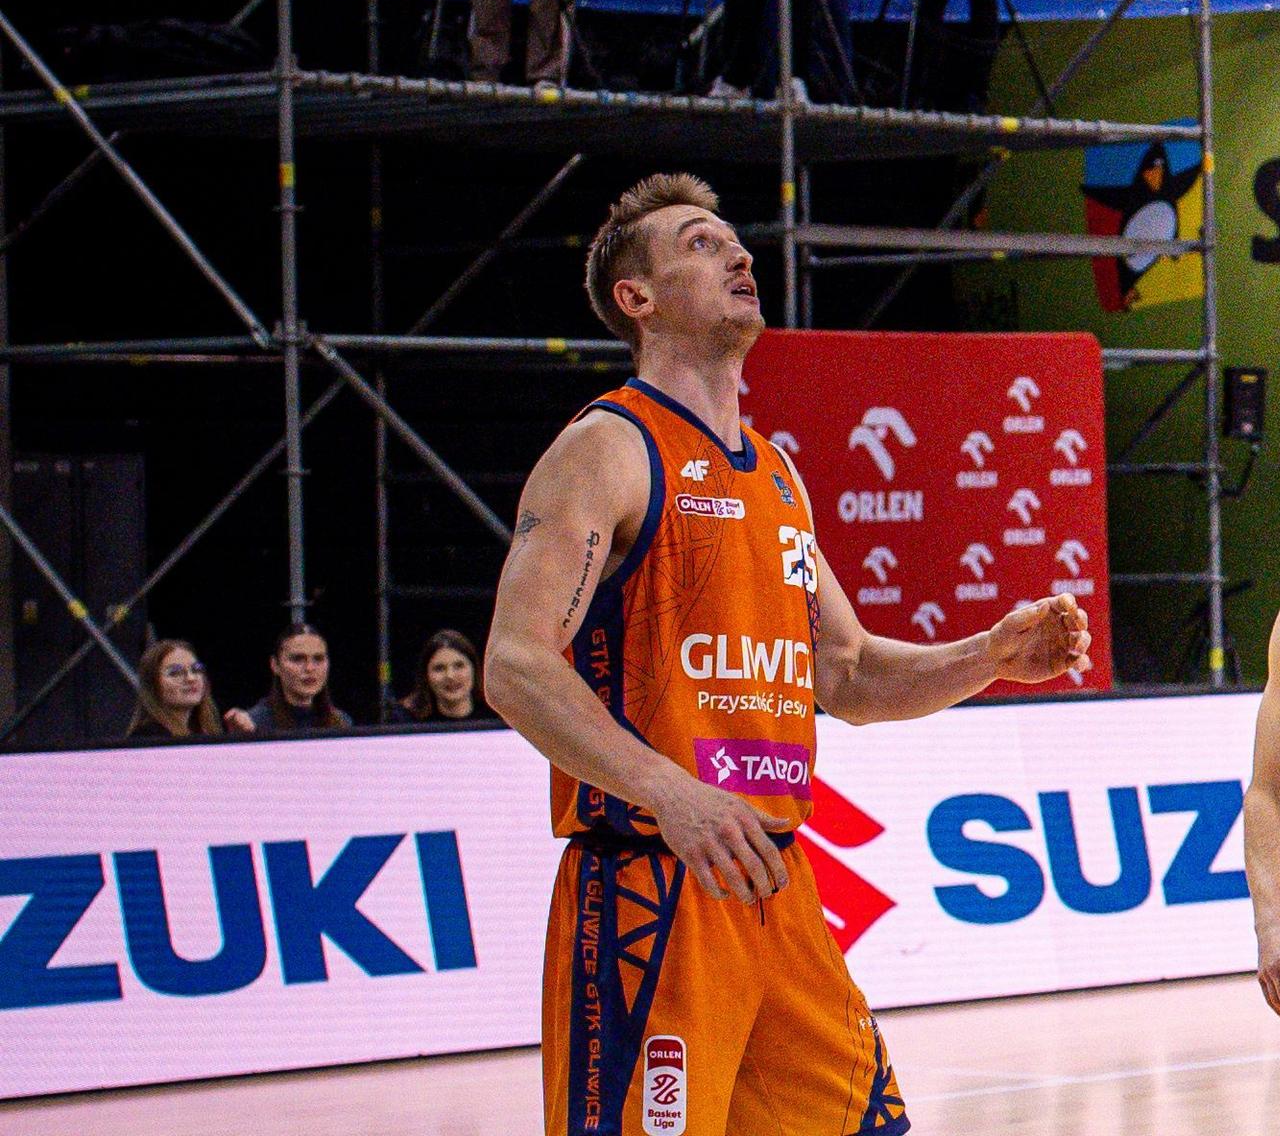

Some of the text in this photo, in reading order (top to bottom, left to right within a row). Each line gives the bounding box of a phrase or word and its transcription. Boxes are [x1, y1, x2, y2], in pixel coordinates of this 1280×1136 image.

[1003, 415, 1045, 432] ORLEN
[955, 471, 998, 488] ORLEN
[1050, 469, 1092, 486] ORLEN
[837, 490, 924, 522] ORLEN
[1003, 528, 1046, 546] ORLEN
[857, 587, 901, 604] ORLEN
[955, 583, 998, 600] ORLEN
[583, 982, 602, 1031] GTK
[648, 1048, 683, 1061] ORLEN
[583, 1038, 602, 1130] GLIWICE
[647, 1108, 682, 1120] Basket
[653, 1119, 676, 1131] Liga
